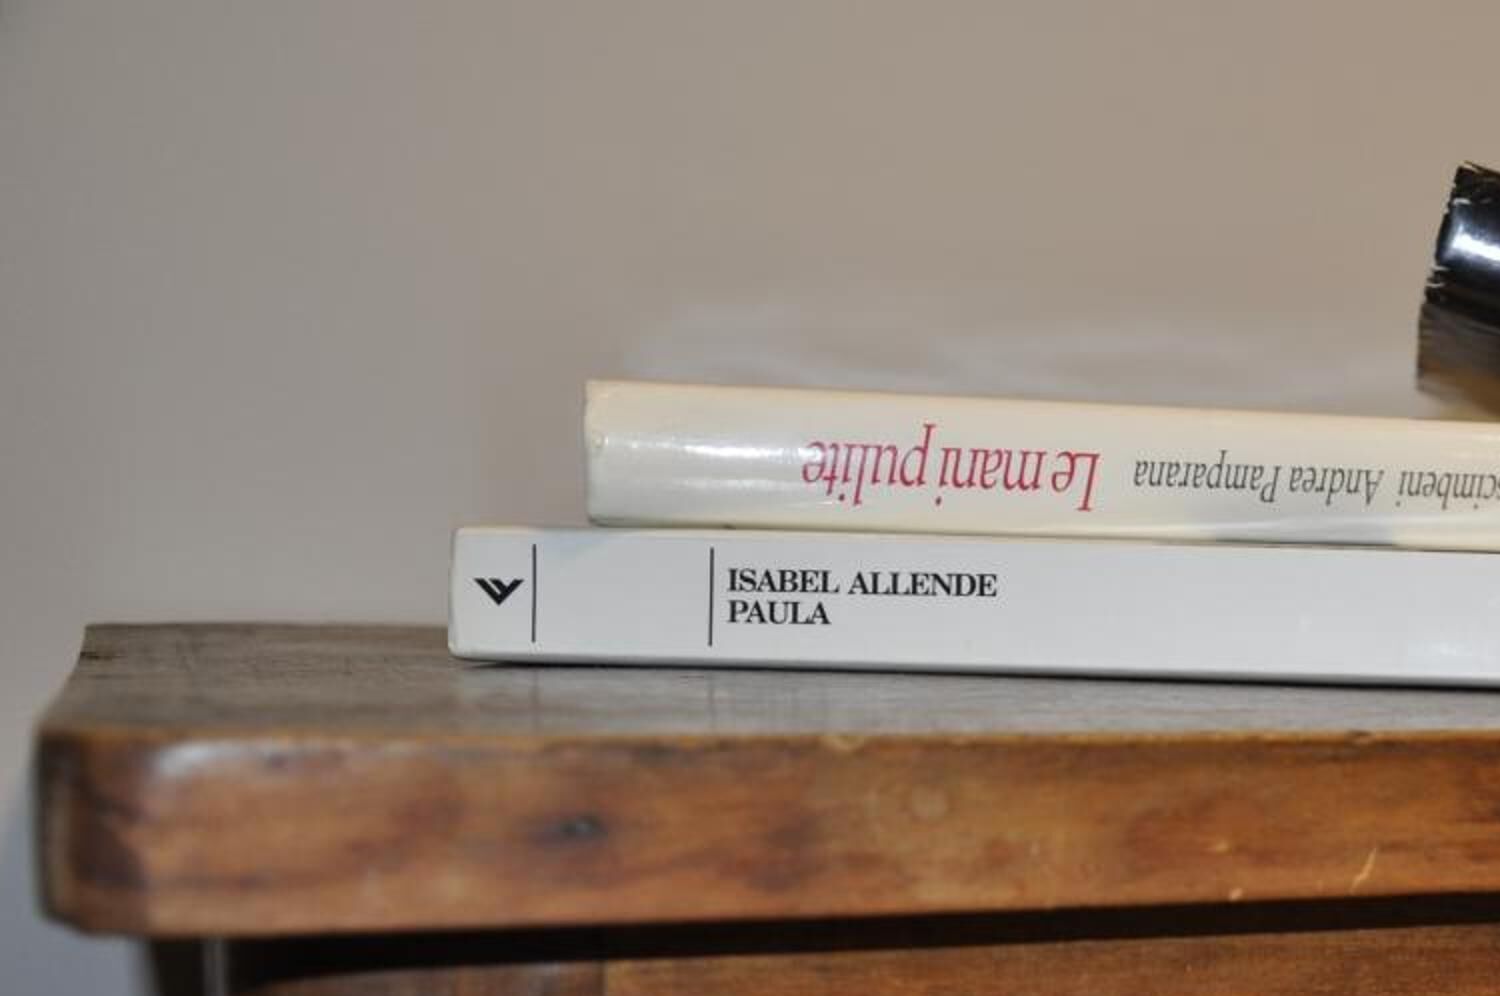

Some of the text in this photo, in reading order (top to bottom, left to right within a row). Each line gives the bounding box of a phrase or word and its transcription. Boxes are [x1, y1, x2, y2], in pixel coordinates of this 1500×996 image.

[801, 423, 1101, 512] Le mani pulite
[1133, 450, 1280, 503] Pamparana
[1288, 465, 1384, 505] Andrea
[728, 568, 998, 598] ISABEL ALLENDE
[728, 600, 831, 625] PAULA
